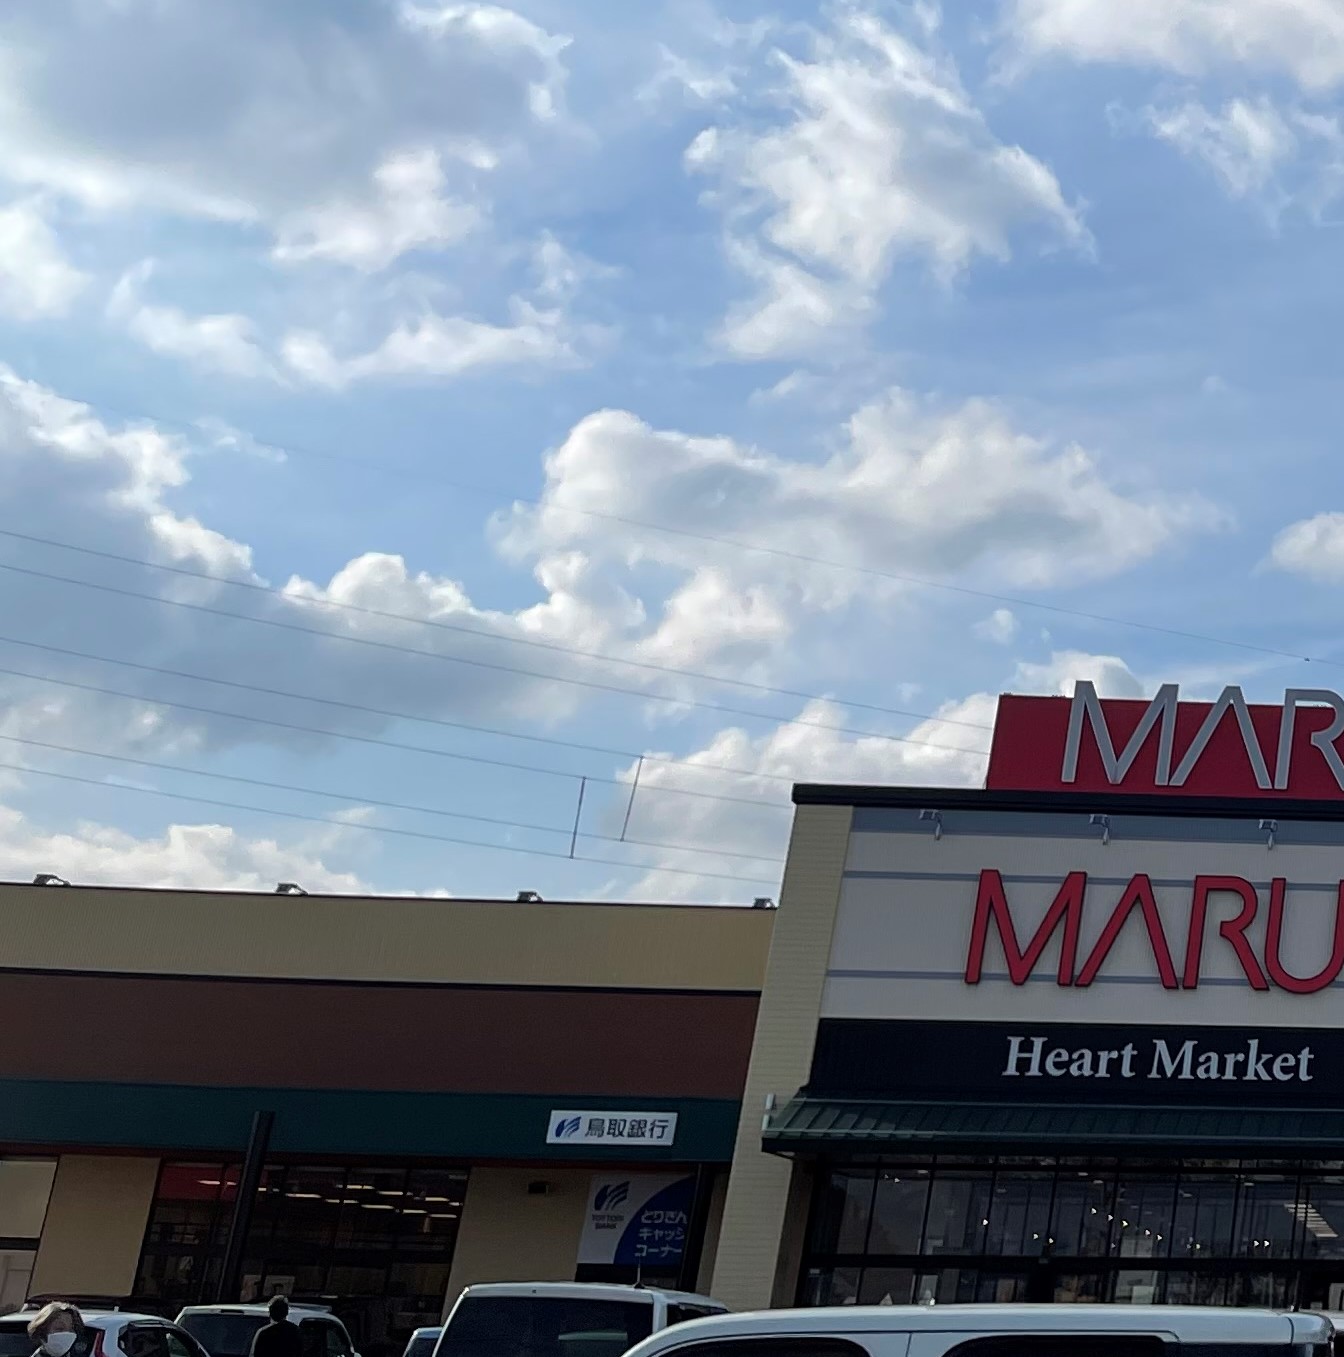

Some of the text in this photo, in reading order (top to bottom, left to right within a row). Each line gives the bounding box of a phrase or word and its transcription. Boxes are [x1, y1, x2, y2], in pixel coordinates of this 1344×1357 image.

[1002, 1036, 1315, 1081] Heart Market
[586, 1118, 669, 1140] 鳥取銀行
[639, 1227, 685, 1241] キャッシ
